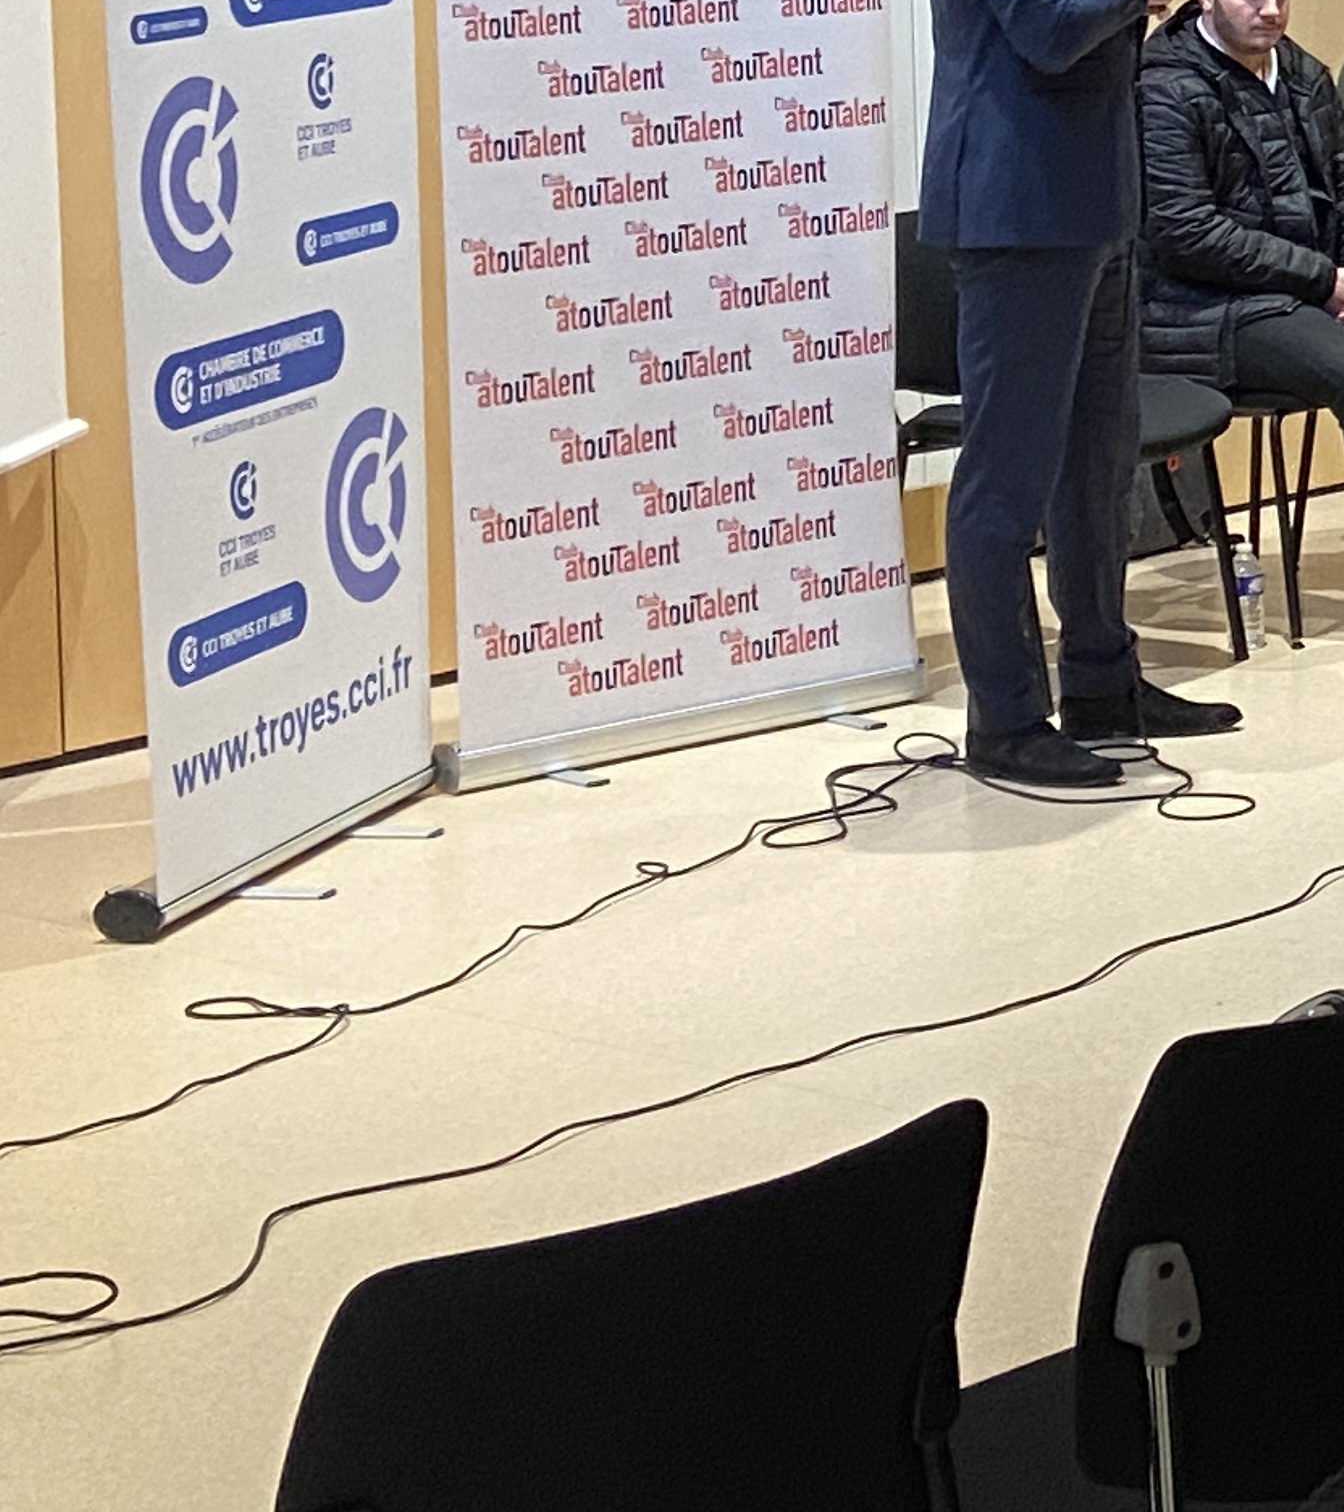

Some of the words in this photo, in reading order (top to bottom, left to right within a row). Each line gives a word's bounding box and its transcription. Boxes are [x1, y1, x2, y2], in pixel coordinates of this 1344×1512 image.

[465, 6, 581, 41] atouTalent
[548, 62, 664, 97] atouTalent
[712, 48, 822, 83] atouTalent
[632, 111, 743, 147] atouTalent
[785, 97, 886, 133] atouTalent
[469, 126, 585, 163] atouTalent
[553, 172, 668, 210] atouTalent
[716, 156, 826, 193] atouTalent
[473, 236, 589, 276] atouTalent
[635, 218, 747, 257] atouTalent
[719, 272, 830, 310] atouTalent
[556, 292, 672, 332] atouTalent
[640, 345, 751, 386] atouTalent
[478, 366, 594, 408] atouTalent
[723, 398, 833, 439] atouTalent
[561, 421, 676, 464] atouTalent
[644, 474, 755, 517] atouTalent
[482, 498, 599, 543] atouTalent
[727, 511, 836, 554] atouTalent
[565, 537, 679, 582] atouTalent
[800, 559, 905, 602] atouTalent
[647, 585, 759, 630] atouTalent
[485, 613, 603, 660] atouTalent
[730, 620, 839, 665] atouTalent
[569, 650, 683, 697] atouTalent
[172, 644, 413, 799] www.troyes.cci.fr
